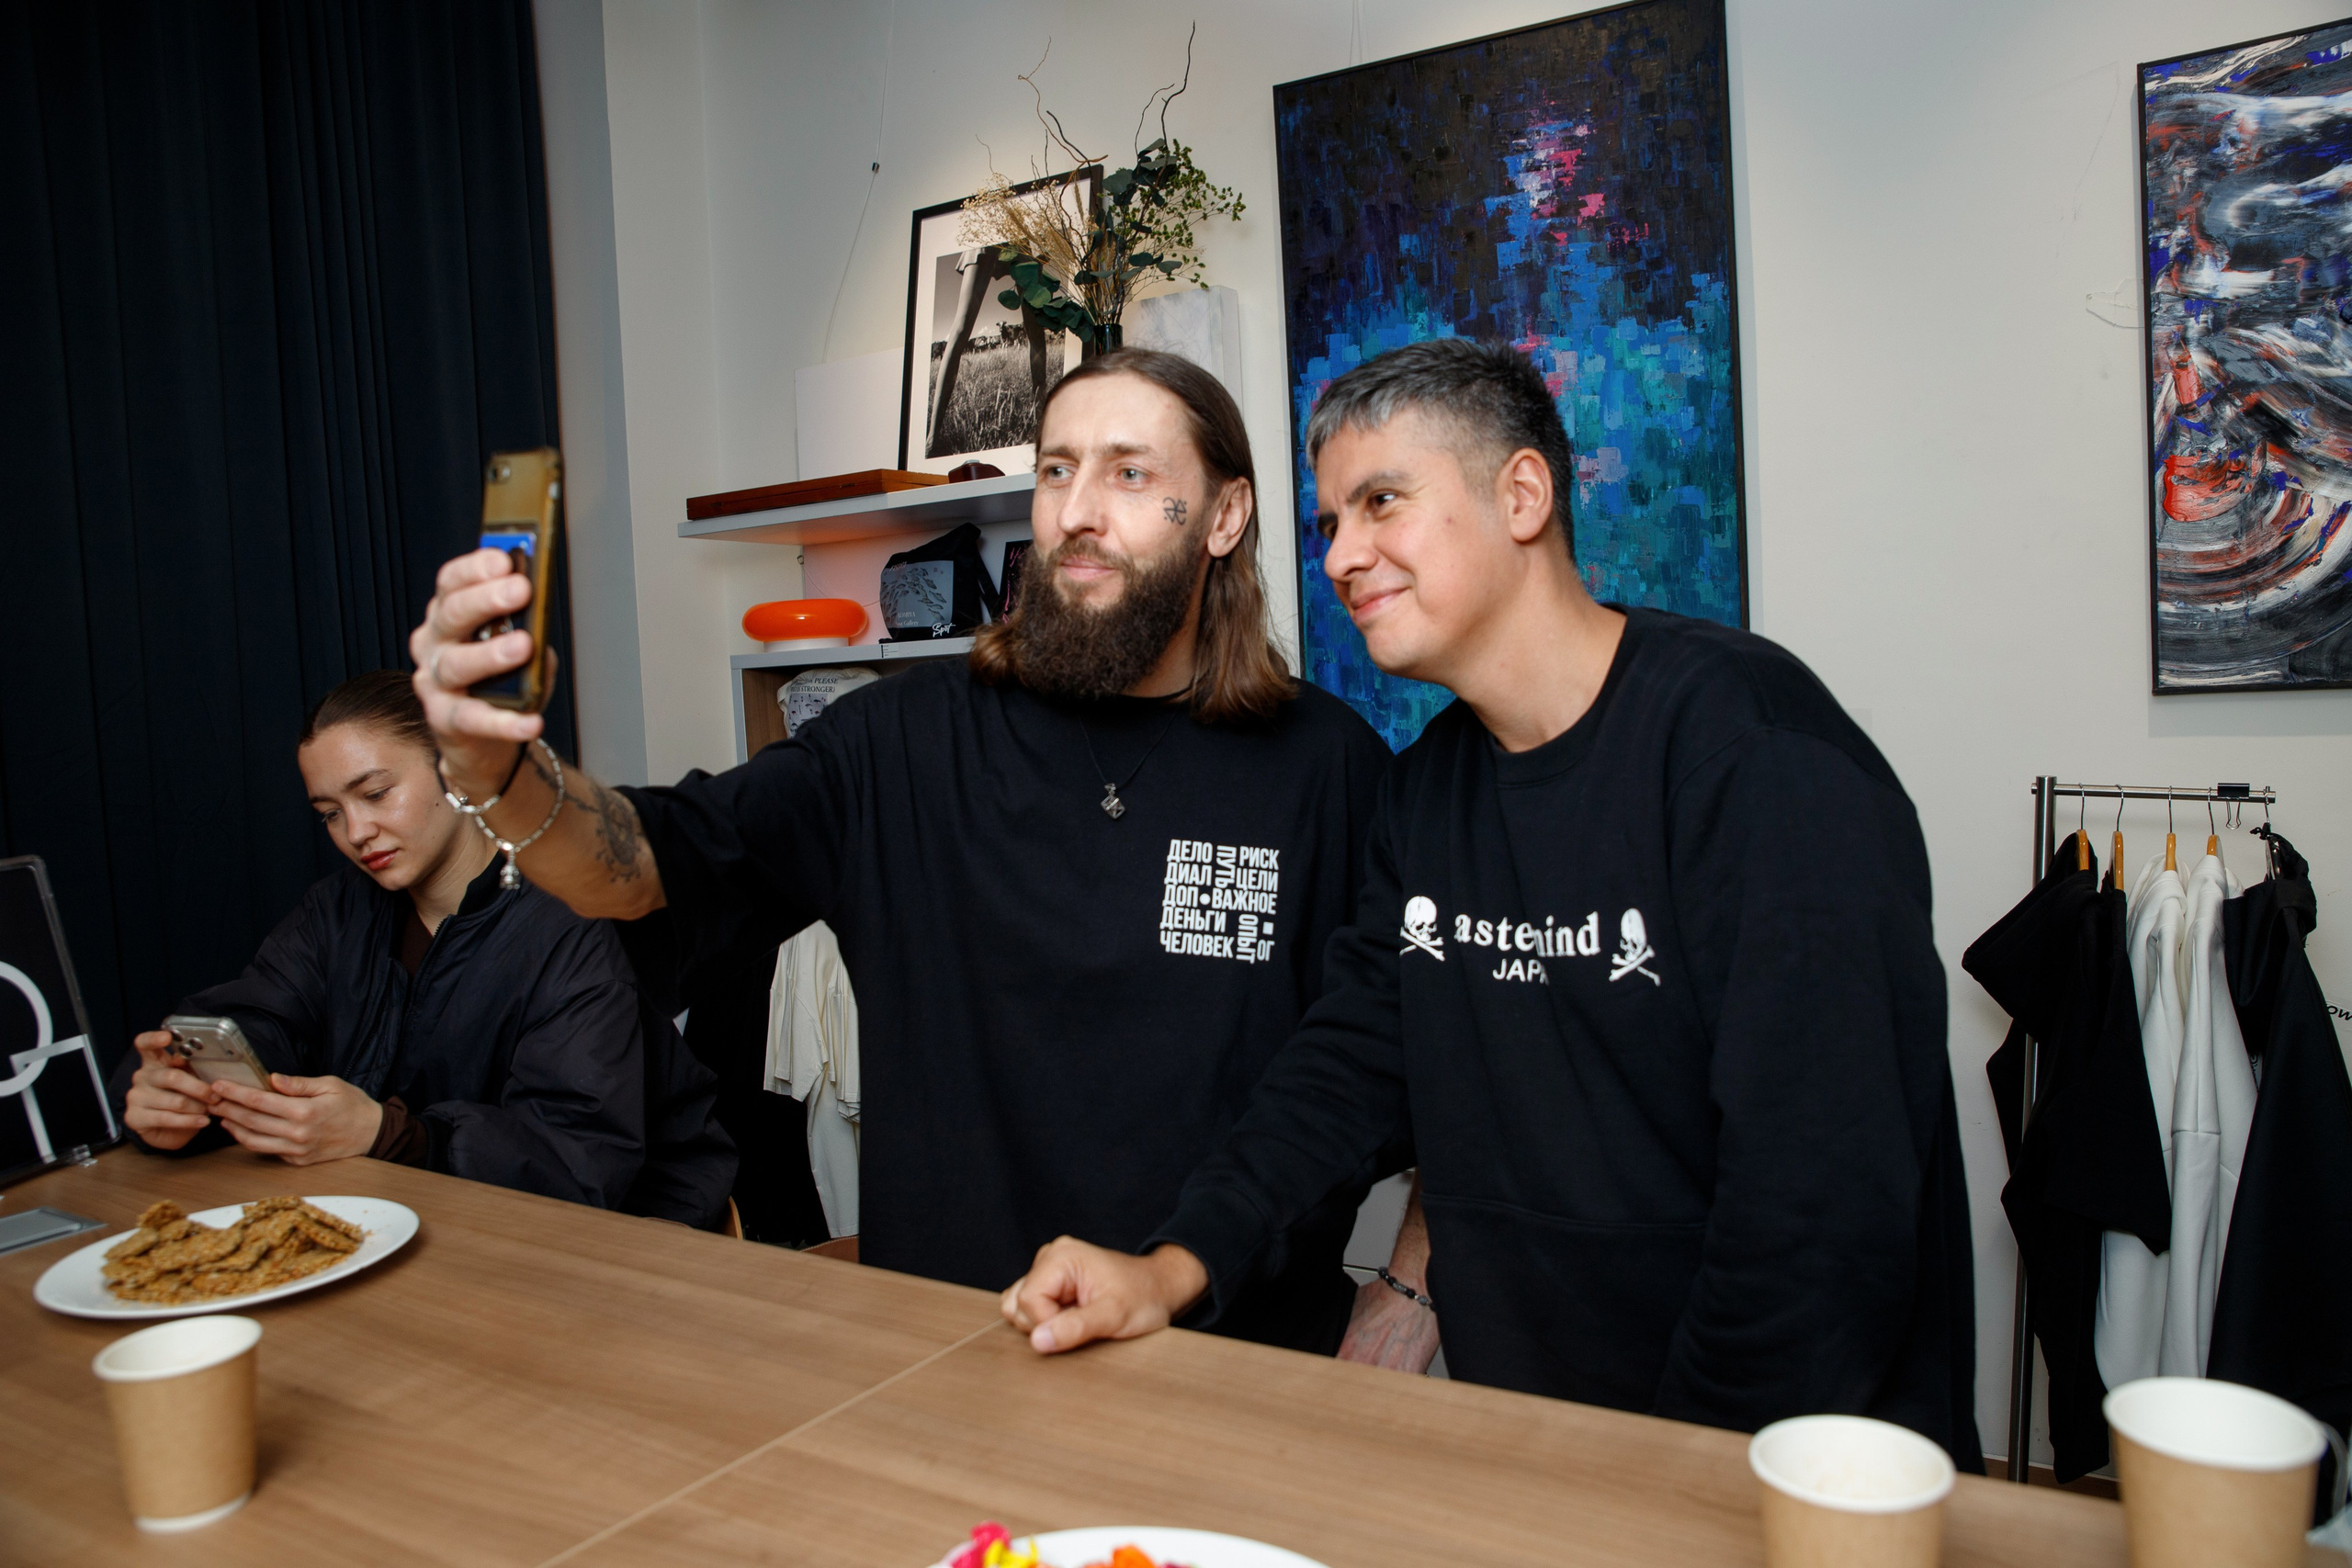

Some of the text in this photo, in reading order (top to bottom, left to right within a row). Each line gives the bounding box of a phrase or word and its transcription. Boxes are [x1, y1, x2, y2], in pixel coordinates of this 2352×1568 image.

[933, 623, 956, 637] Spot
[1167, 839, 1213, 863] ДЕЛО
[1239, 846, 1280, 870] РИСК
[1164, 862, 1213, 886] ДИАЛ
[1215, 845, 1237, 889] ПУТЬ
[1236, 867, 1279, 893] ЦЕЛИ
[1162, 884, 1278, 915] ДОП ВАЖНОЕ
[1159, 907, 1227, 933] ДЕНЬГИ
[1159, 931, 1235, 958] ЧЕЛОВЕК
[1236, 914, 1259, 964] ОПЫТ
[1257, 940, 1275, 962] ОГ
